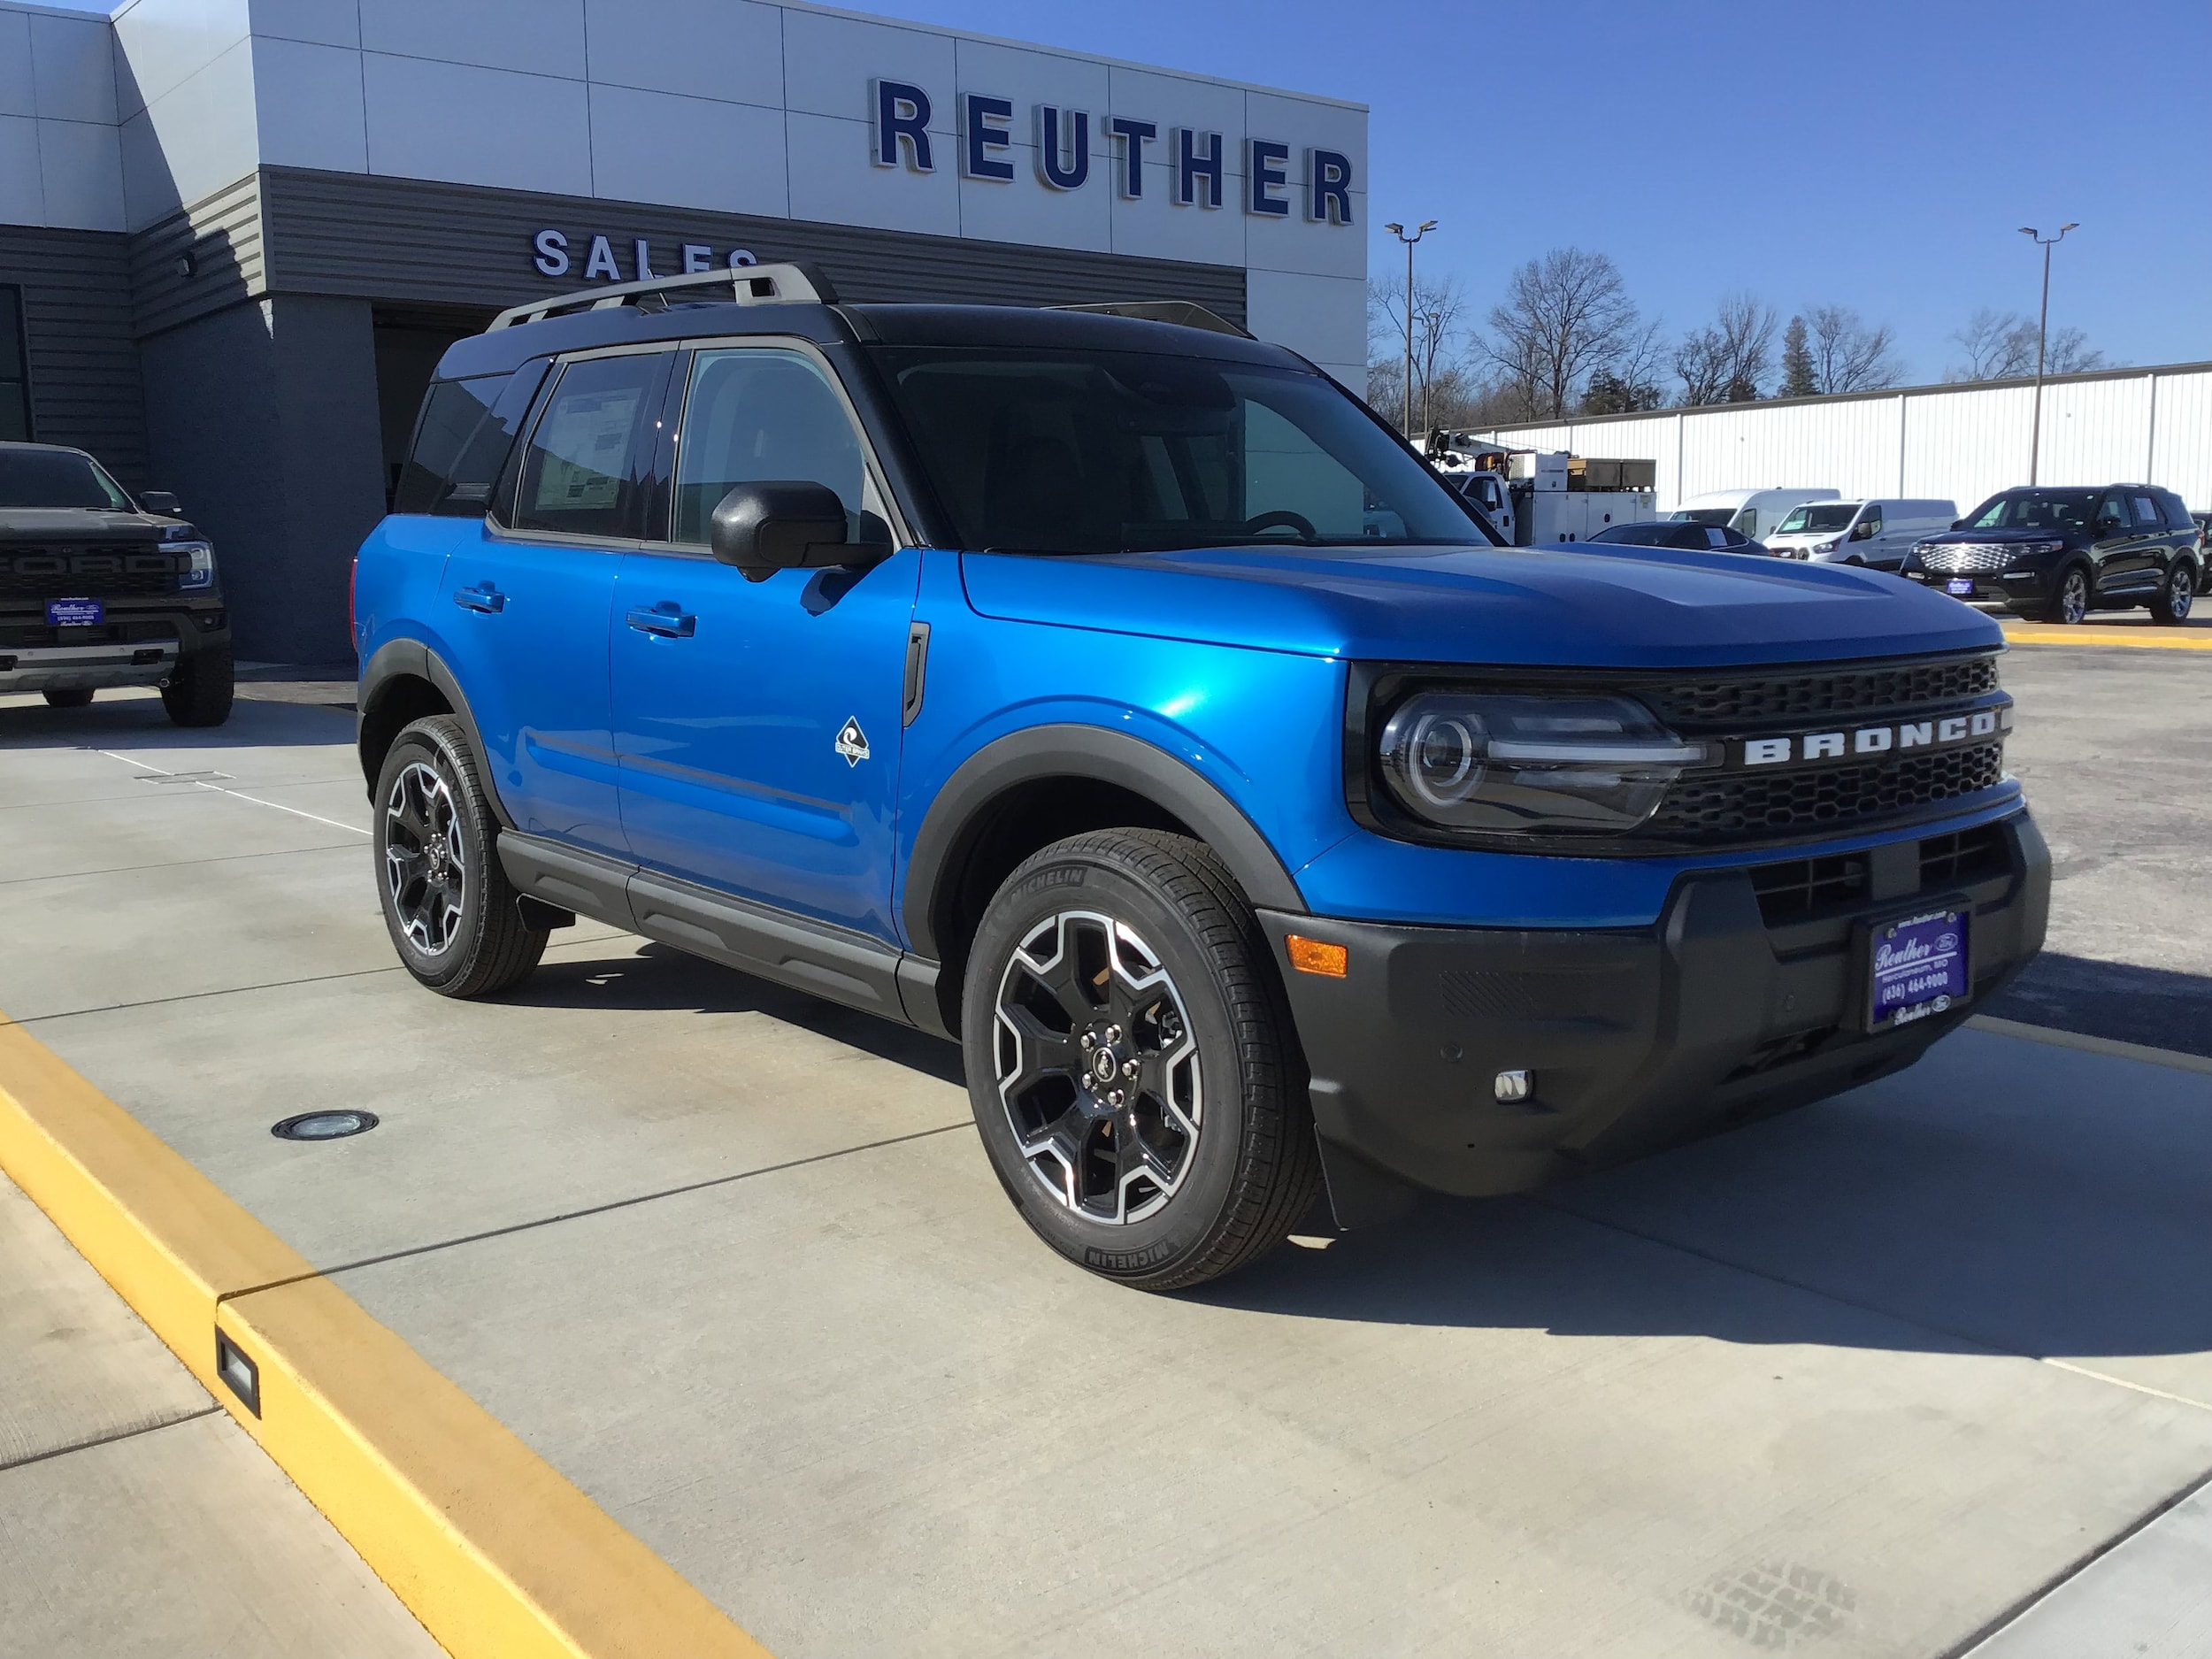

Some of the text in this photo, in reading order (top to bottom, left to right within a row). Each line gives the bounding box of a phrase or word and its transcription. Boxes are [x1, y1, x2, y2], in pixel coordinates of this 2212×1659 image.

[868, 77, 1355, 226] REUTHER
[0, 557, 176, 574] ORD
[1745, 711, 1995, 765] BRONCO
[1010, 868, 1084, 902] MICHELIN
[1088, 1240, 1170, 1269] MICHELIN
